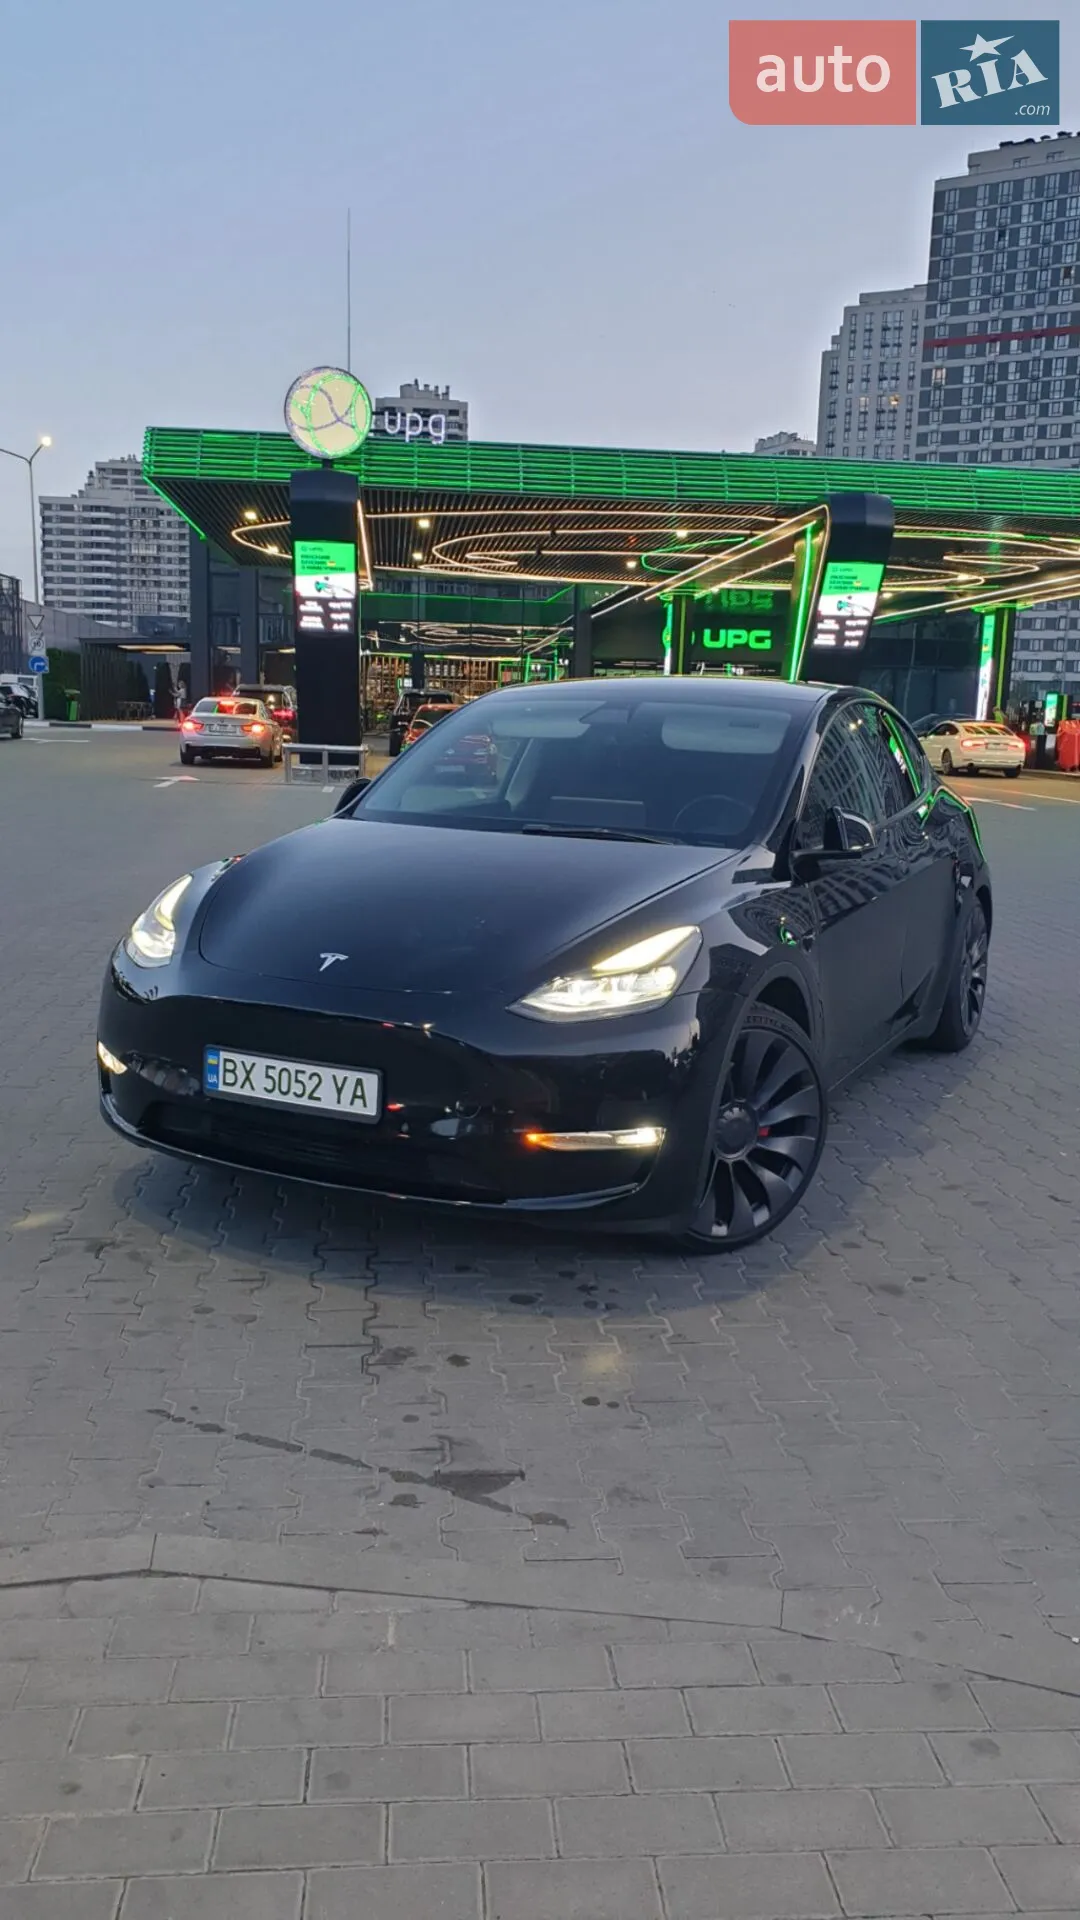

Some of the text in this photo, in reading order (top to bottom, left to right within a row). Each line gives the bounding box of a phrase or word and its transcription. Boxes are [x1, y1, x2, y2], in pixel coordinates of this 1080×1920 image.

[384, 411, 446, 444] upg
[703, 628, 772, 650] UPG
[207, 1074, 218, 1084] UA
[222, 1058, 368, 1108] BX 5052 YA
